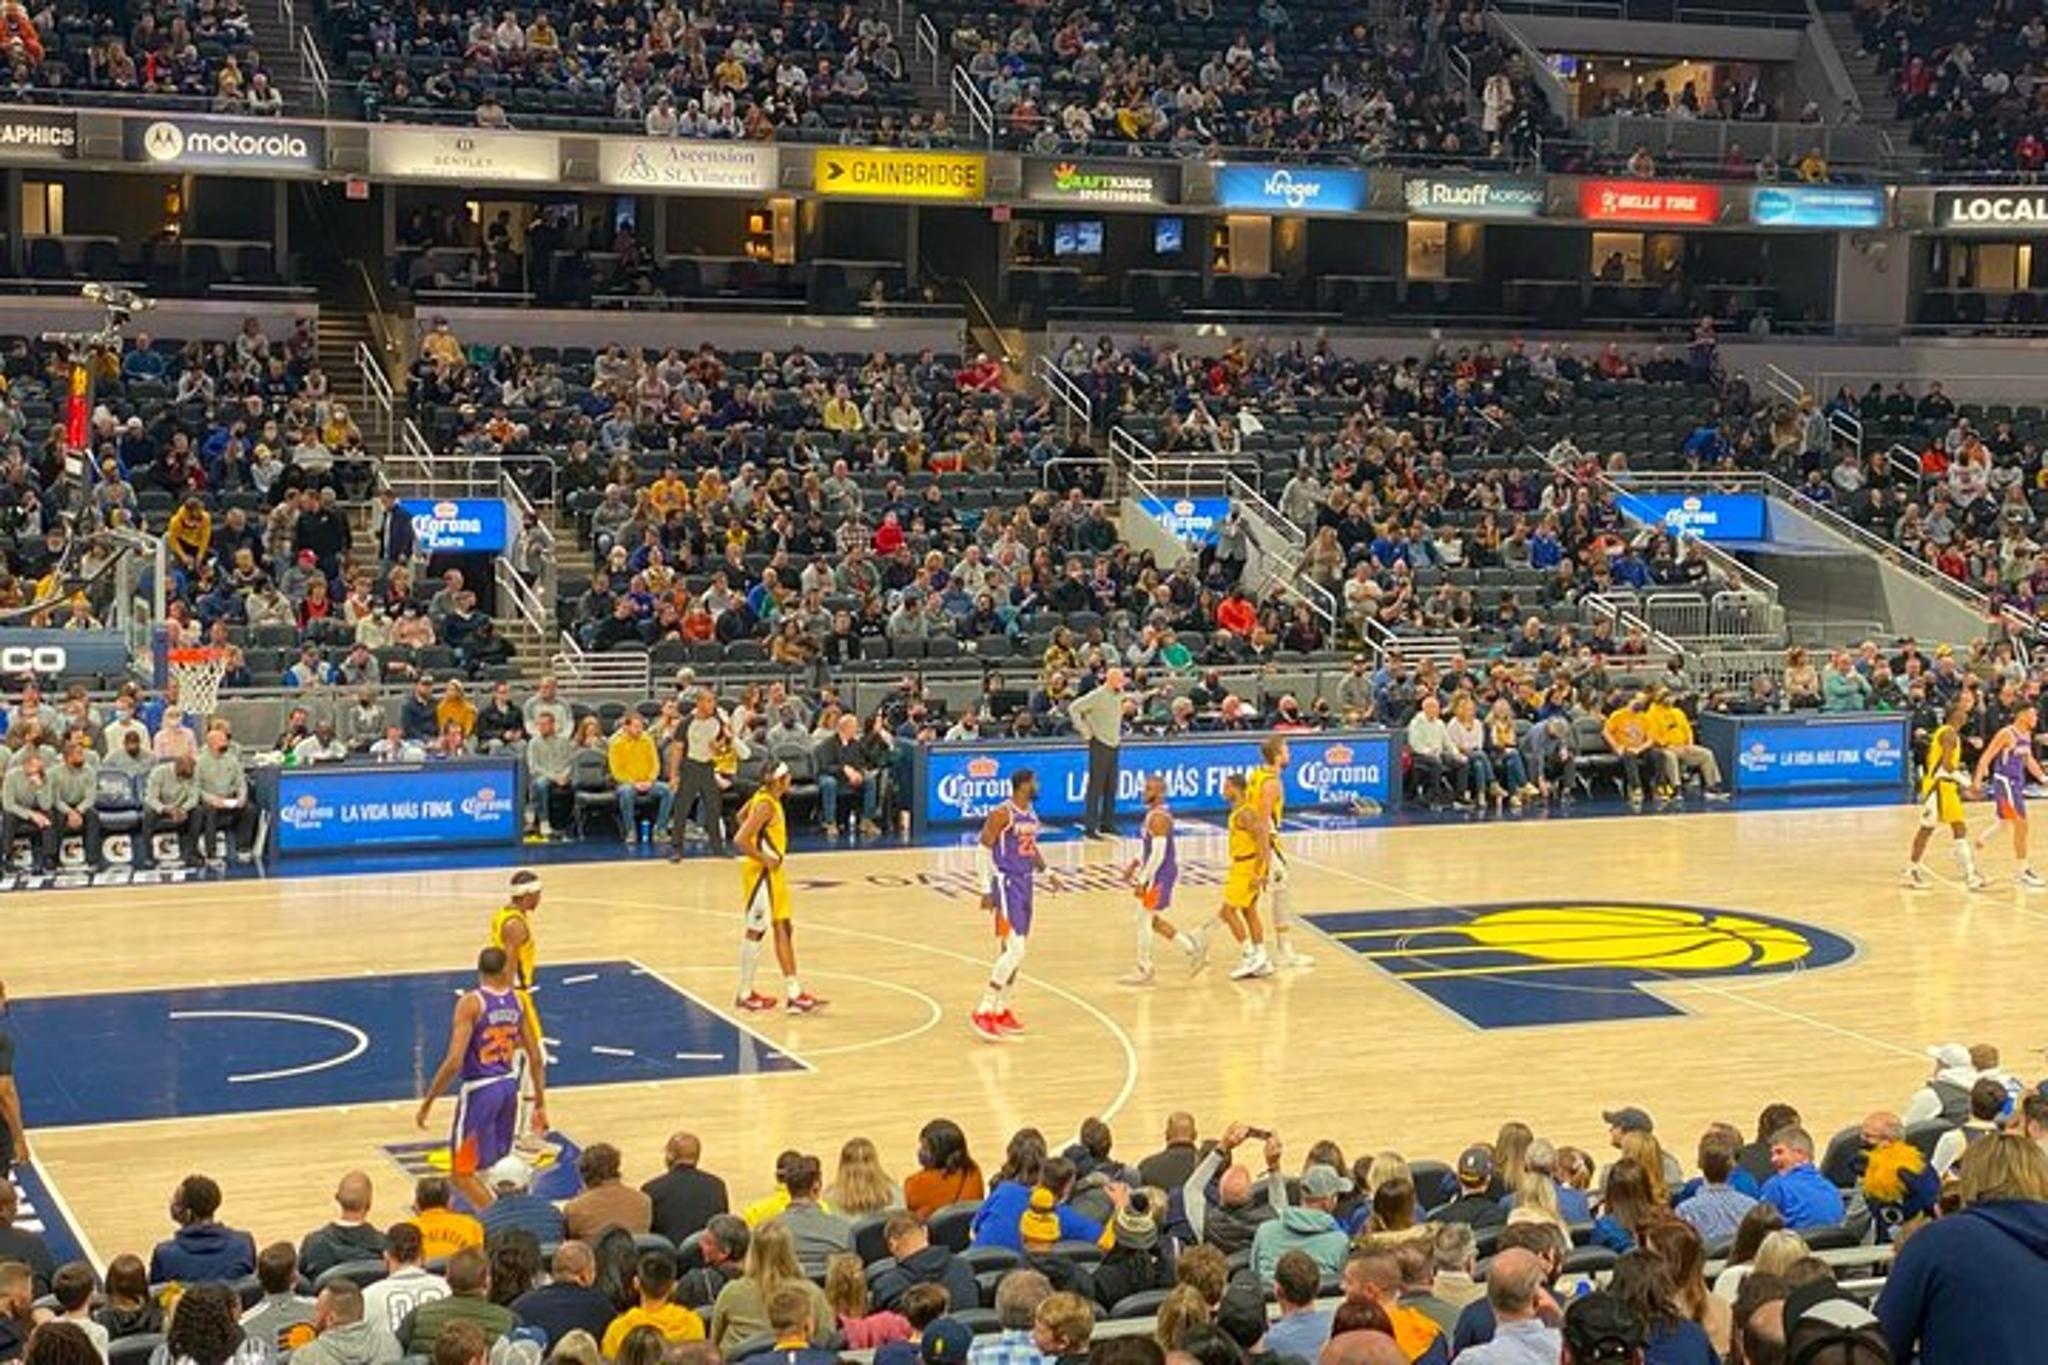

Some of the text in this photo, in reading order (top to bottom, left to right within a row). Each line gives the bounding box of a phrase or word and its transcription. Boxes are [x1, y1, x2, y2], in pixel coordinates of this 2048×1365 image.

[0, 121, 75, 146] APHICS
[187, 131, 308, 157] motorola
[667, 146, 756, 165] Ascension
[852, 161, 976, 189] GAINBRIDGE
[1264, 170, 1320, 208] Kroger
[1432, 183, 1490, 206] Ruoff
[1617, 192, 1697, 211] BELLE TIRE
[411, 514, 482, 536] Corona
[2, 647, 66, 672] CO
[938, 773, 1013, 806] Coron
[1297, 761, 1379, 793] Corona
